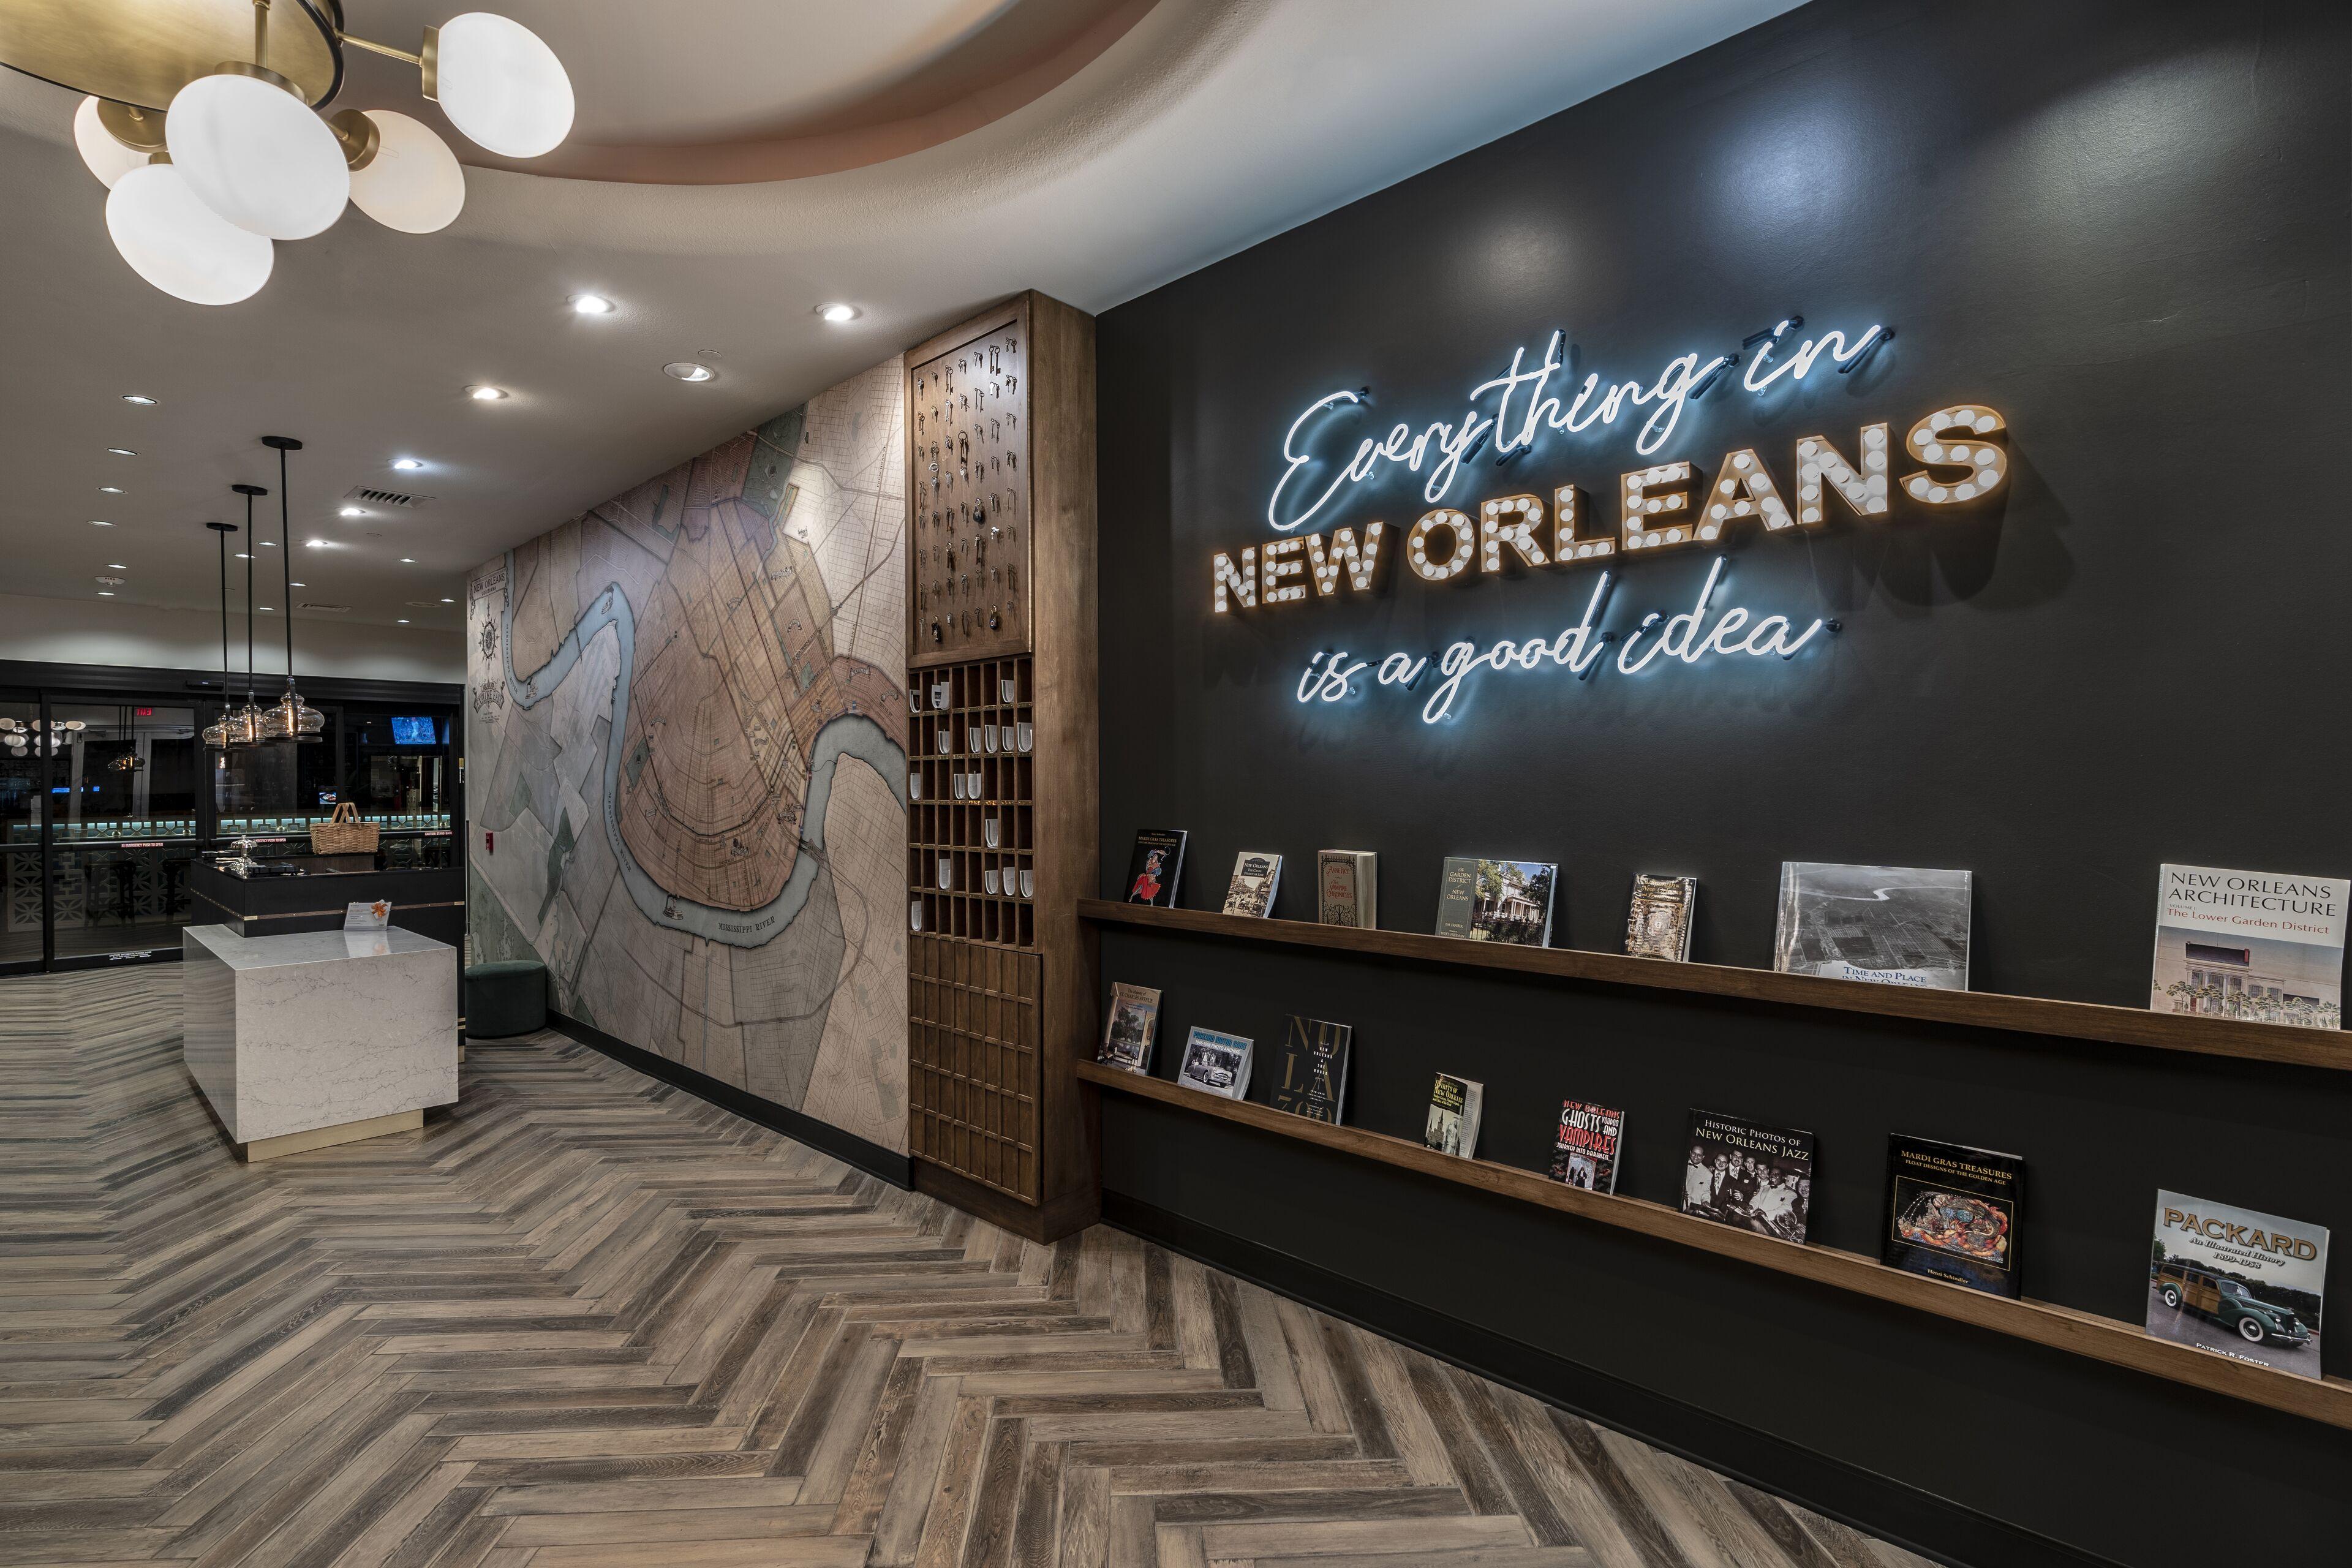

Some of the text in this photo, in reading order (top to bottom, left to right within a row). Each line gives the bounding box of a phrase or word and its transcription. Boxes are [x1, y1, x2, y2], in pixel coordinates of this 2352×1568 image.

[1268, 320, 1882, 531] Everything in
[1213, 404, 2008, 613] NEW ORLEANS
[473, 582, 484, 594] NEW
[1297, 556, 1822, 725] is a good idea
[1326, 889, 1352, 899] CHRONICLES
[1329, 882, 1348, 892] VAMPIRE
[2171, 872, 2331, 899] NEW ORLEANS
[2168, 888, 2337, 917] ARCHITECTURE
[718, 916, 775, 933] MISSISSIPPI RIVER
[2166, 908, 2329, 935] The Lower Garden District
[1844, 966, 1869, 976] TIME
[1894, 972, 1927, 983] PLACE
[1193, 1030, 1247, 1050] PACKARD MOTOR CARS
[1434, 1086, 1464, 1104] NEW ORLEANS
[1563, 1099, 1620, 1120] NEW ORLEANS
[1561, 1108, 1619, 1133] GHOSTS VOODOO
[1602, 1125, 1618, 1137] AND
[1559, 1124, 1616, 1155] VAMPIRES
[1695, 1126, 1809, 1161] NEW ORLEANS JAZZ
[1705, 1119, 1801, 1147] HISTORIC PHOTOS OF
[1556, 1142, 1576, 1152] JOURNEY
[1575, 1147, 1586, 1155] INTO
[1901, 1150, 2013, 1180] MARDI GRAS TREASURES
[1923, 1163, 1947, 1173] DESIGNS
[1968, 1172, 1992, 1183] GOLDEN
[2163, 1207, 2318, 1262] PACKARD
[2188, 1236, 2286, 1267] An Illustrated History
[2212, 1251, 2262, 1270] 1899-1958
[1928, 1268, 1969, 1284] Henri Schindler
[2196, 1342, 2227, 1356] PATRICK
